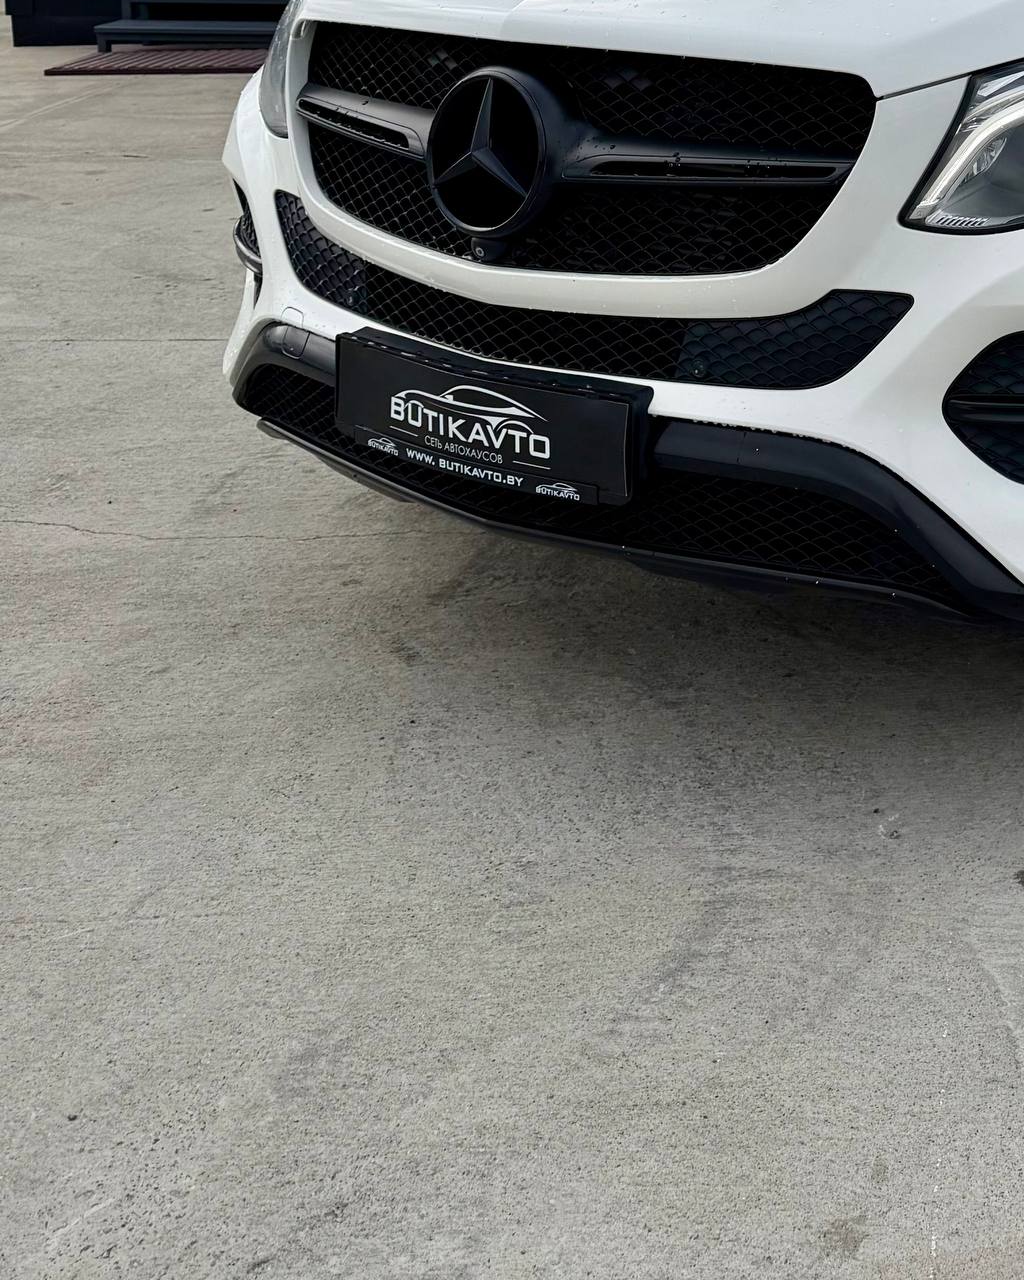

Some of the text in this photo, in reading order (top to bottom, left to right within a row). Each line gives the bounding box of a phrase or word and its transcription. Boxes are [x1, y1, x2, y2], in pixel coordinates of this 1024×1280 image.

[390, 396, 551, 460] BUTIKAVTO
[367, 439, 399, 457] BUTIKAVTO
[424, 435, 504, 464] СЕТЬ АВТОХАУСОВ
[406, 448, 524, 487] WWW. BUTIKAVTO.BY
[535, 486, 581, 501] BUTIKAVTO
